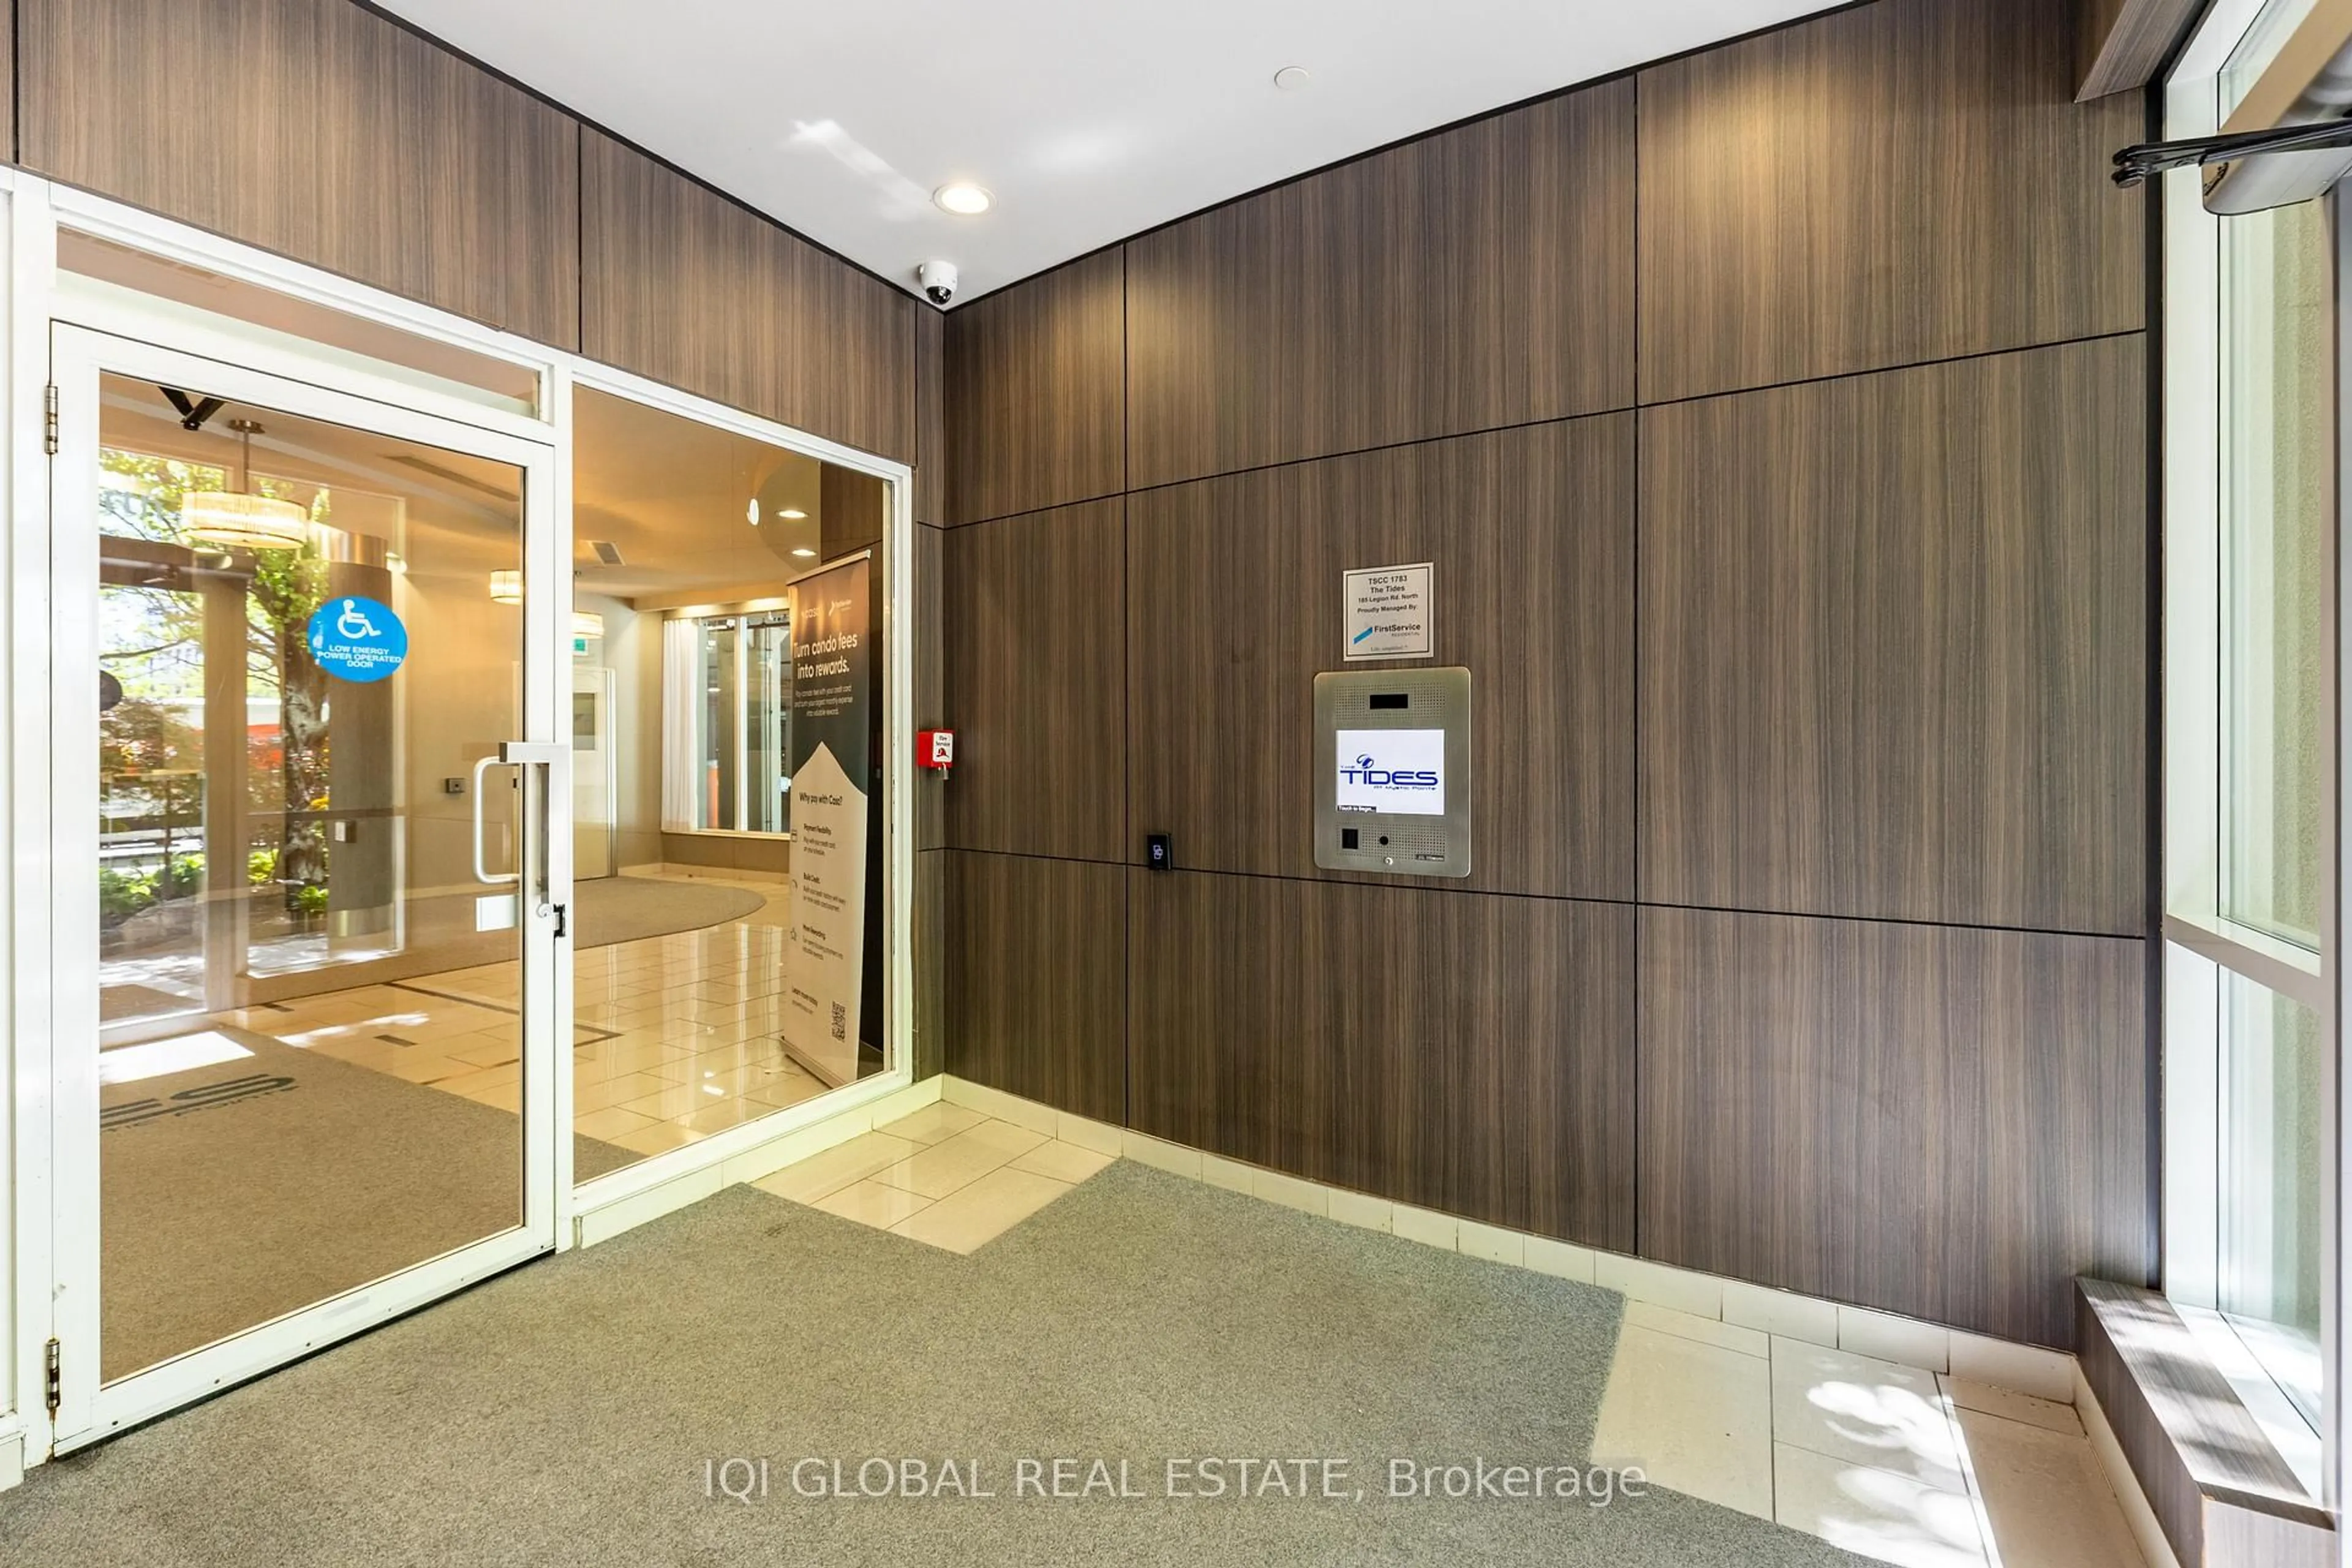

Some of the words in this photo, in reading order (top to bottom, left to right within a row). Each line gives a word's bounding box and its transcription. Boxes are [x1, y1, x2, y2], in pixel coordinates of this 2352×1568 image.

[1368, 576, 1389, 585] TSCC
[1374, 624, 1422, 633] FirstService
[812, 635, 837, 655] condo
[838, 631, 858, 650] fees
[353, 646, 390, 655] ENERGY
[317, 651, 352, 660] POWER
[353, 654, 402, 663] OPERATED
[797, 663, 815, 679] into
[815, 655, 850, 677] rewards.
[1340, 771, 1438, 786] TIDES
